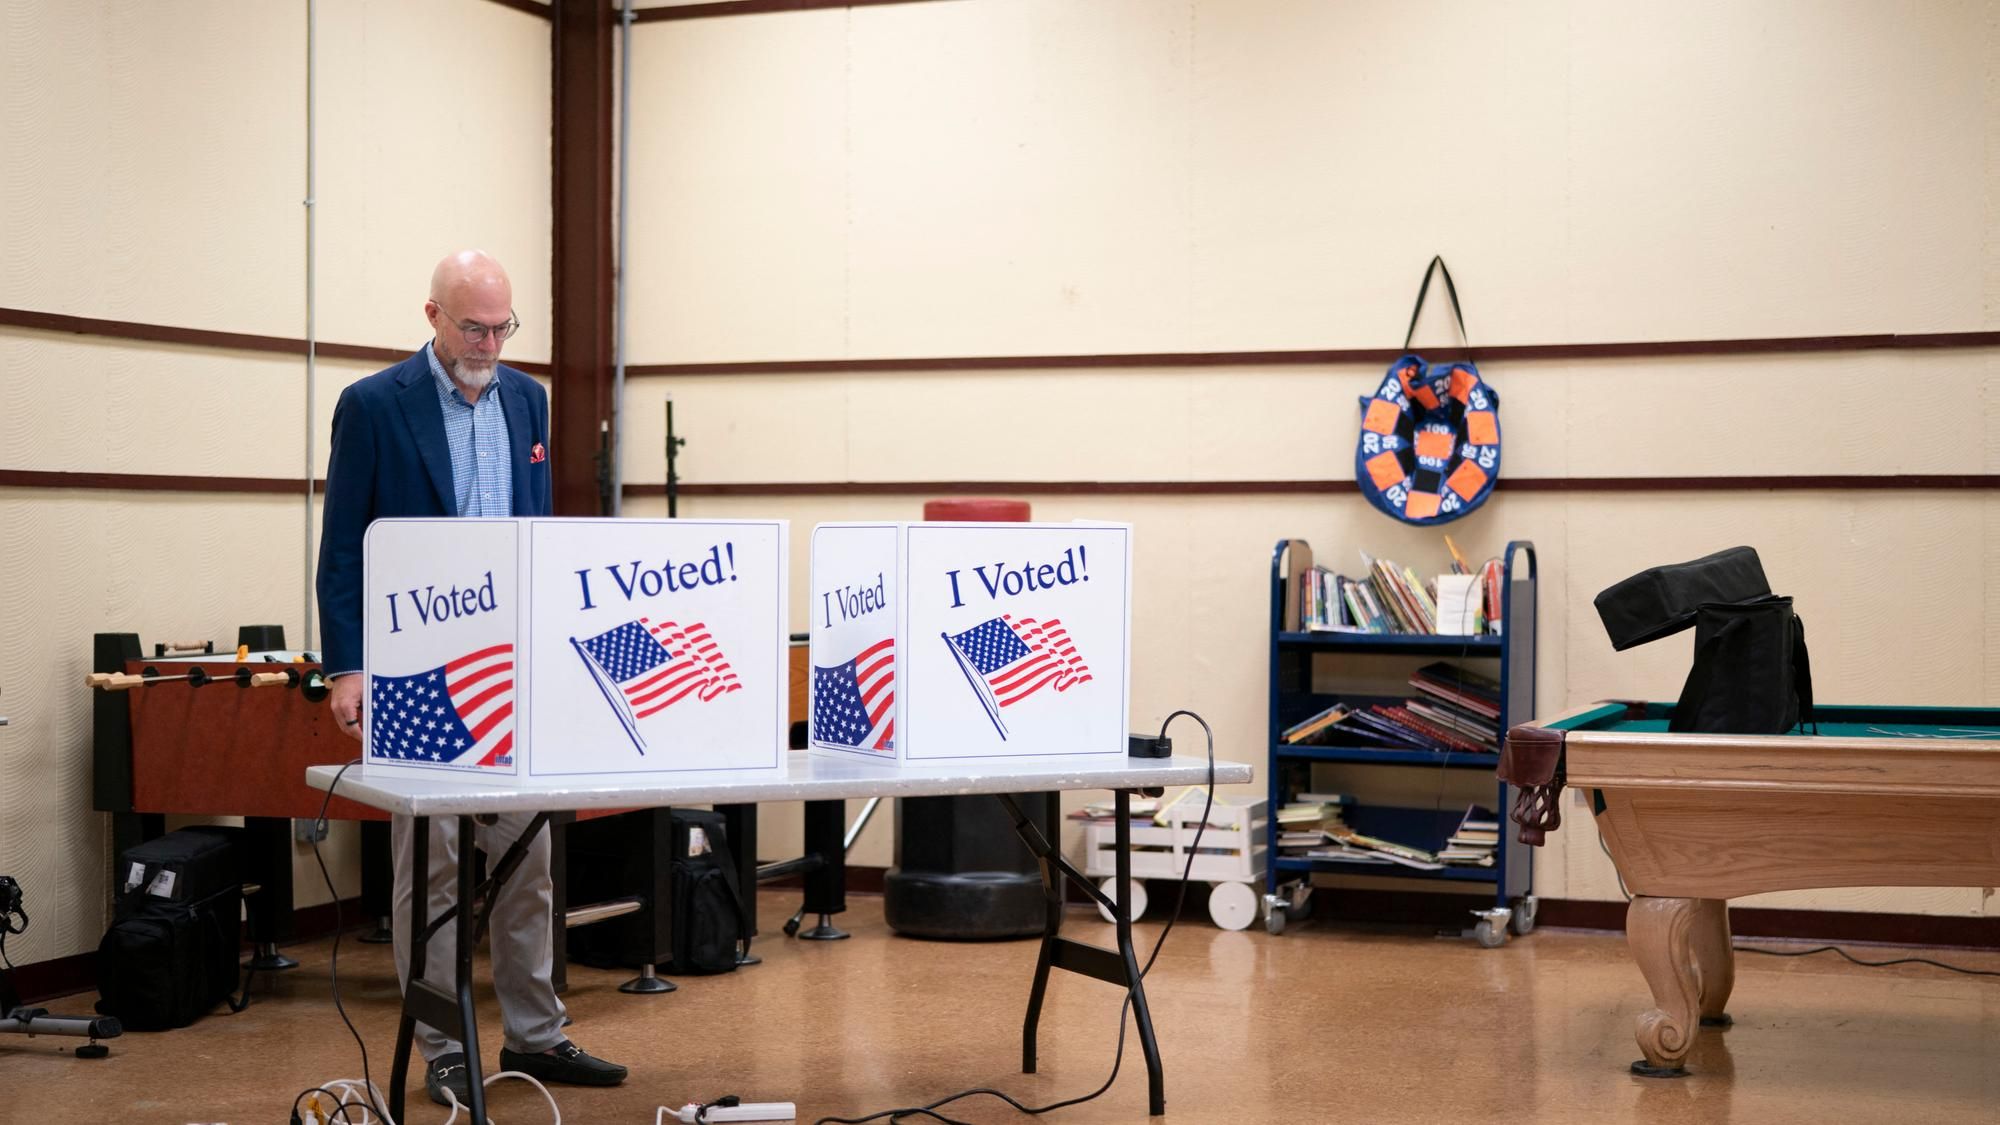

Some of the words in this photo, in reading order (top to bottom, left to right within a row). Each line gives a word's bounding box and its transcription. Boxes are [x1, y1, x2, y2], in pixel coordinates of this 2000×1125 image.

[1381, 378, 1401, 401] 20
[1470, 389, 1487, 409] 20
[1424, 423, 1450, 435] 100
[1363, 432, 1379, 454] 20
[1418, 455, 1443, 468] 100
[1478, 446, 1496, 468] 20
[1386, 485, 1407, 507] 20
[1441, 493, 1460, 512] 20
[575, 568, 597, 610] I
[605, 541, 738, 602] Voted!
[946, 569, 966, 608] I
[973, 544, 1089, 600] Voted!
[386, 592, 402, 633] I
[408, 570, 498, 626] Voted
[823, 592, 832, 629] I
[835, 572, 886, 621] Voted
